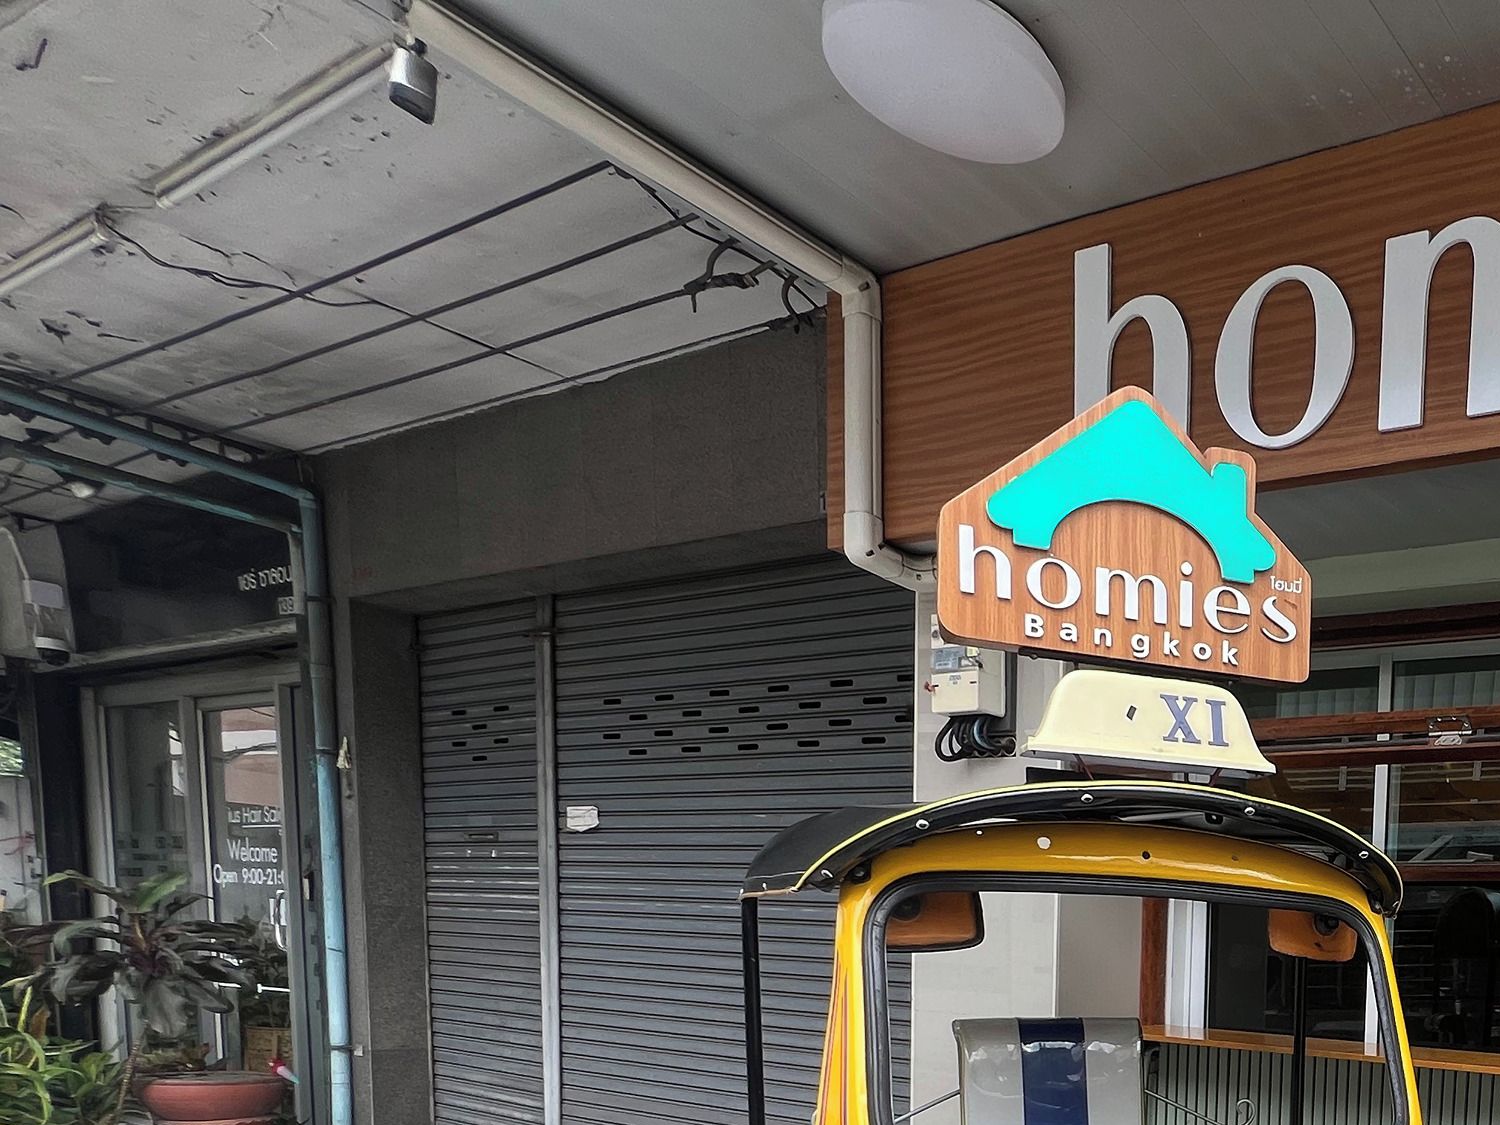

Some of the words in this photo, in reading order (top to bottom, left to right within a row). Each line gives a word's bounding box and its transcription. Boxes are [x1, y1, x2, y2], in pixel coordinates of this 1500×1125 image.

[958, 523, 1298, 643] homies
[1024, 613, 1239, 667] Bangkok
[1160, 694, 1230, 747] XI
[213, 863, 238, 888] Open
[241, 867, 285, 885] 9:00-21:
[226, 837, 278, 863] Welcome
